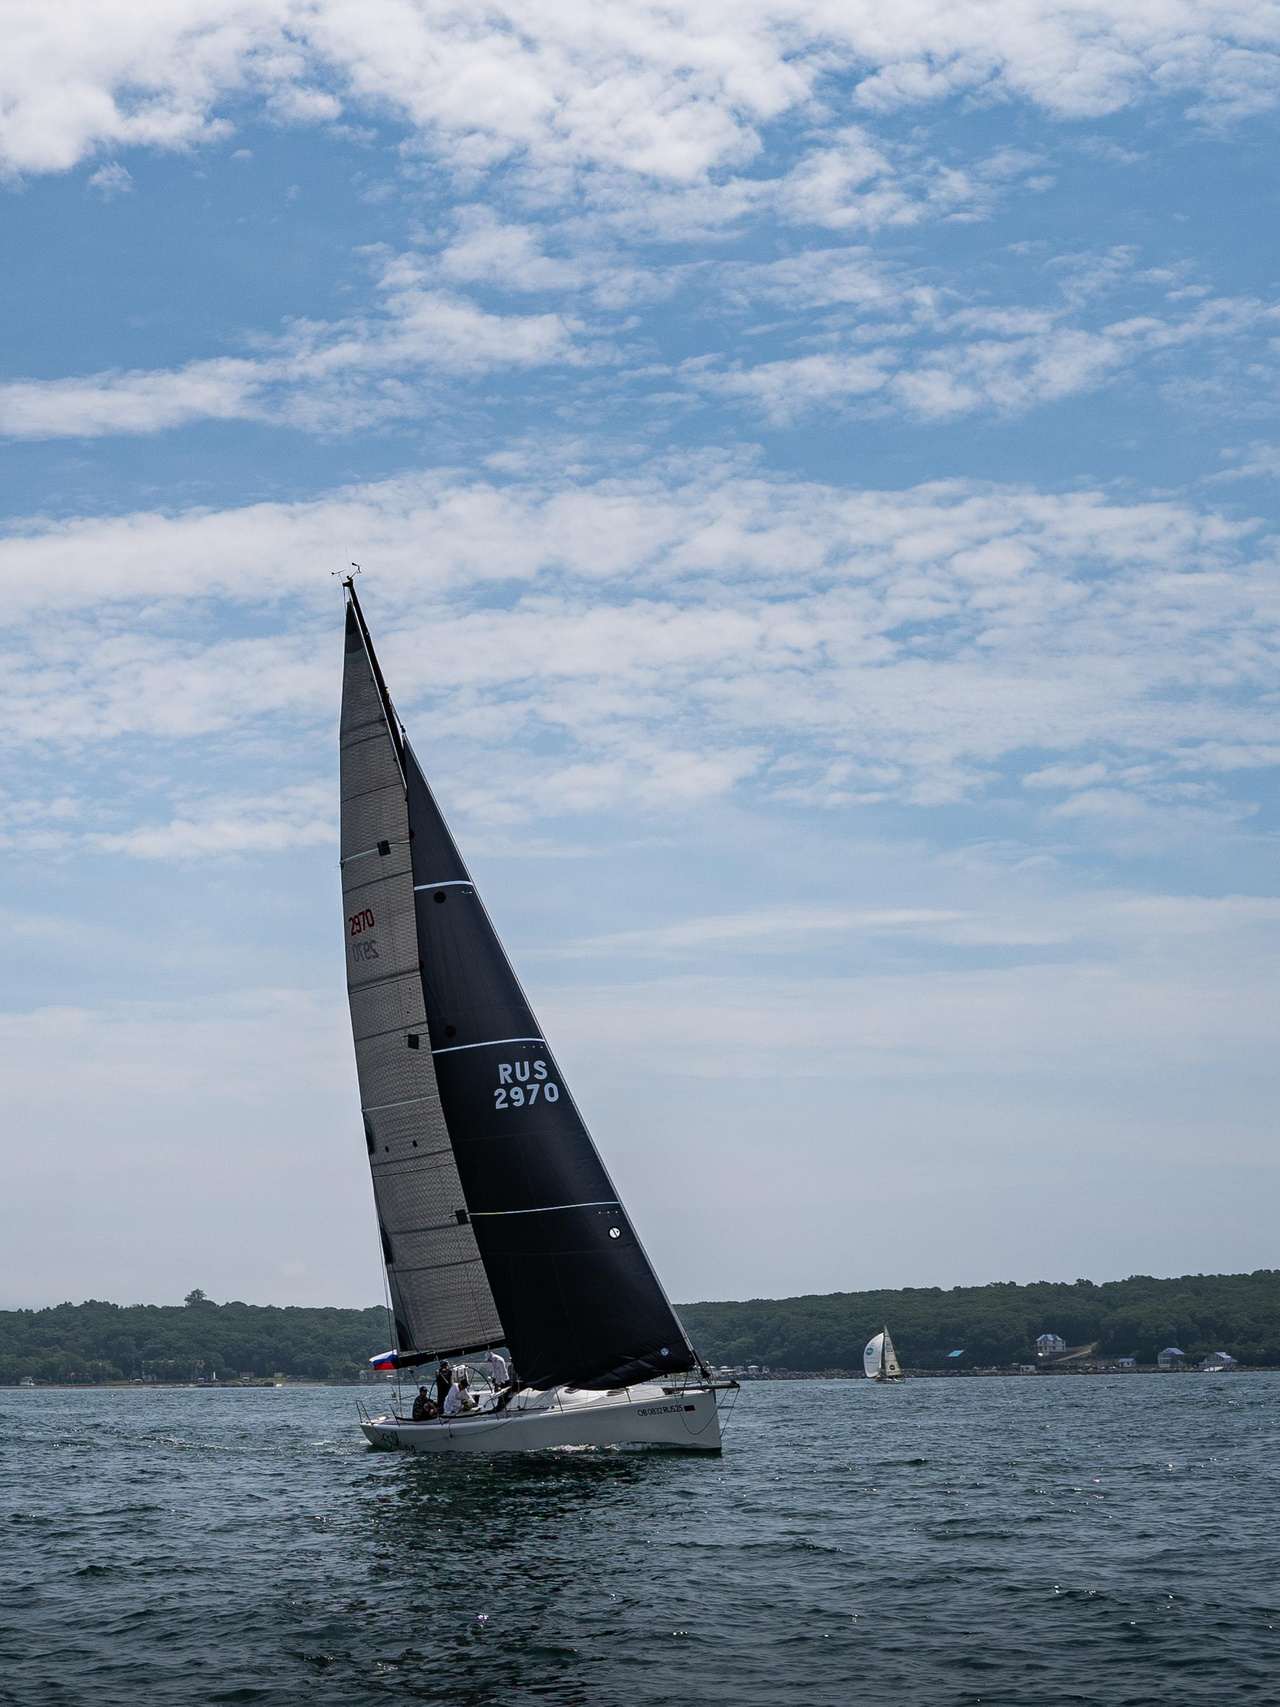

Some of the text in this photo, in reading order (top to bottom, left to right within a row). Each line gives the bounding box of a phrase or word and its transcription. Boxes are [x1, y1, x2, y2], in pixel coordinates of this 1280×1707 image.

[348, 908, 375, 936] 2970
[498, 1060, 548, 1084] RUS
[493, 1082, 559, 1109] 2970
